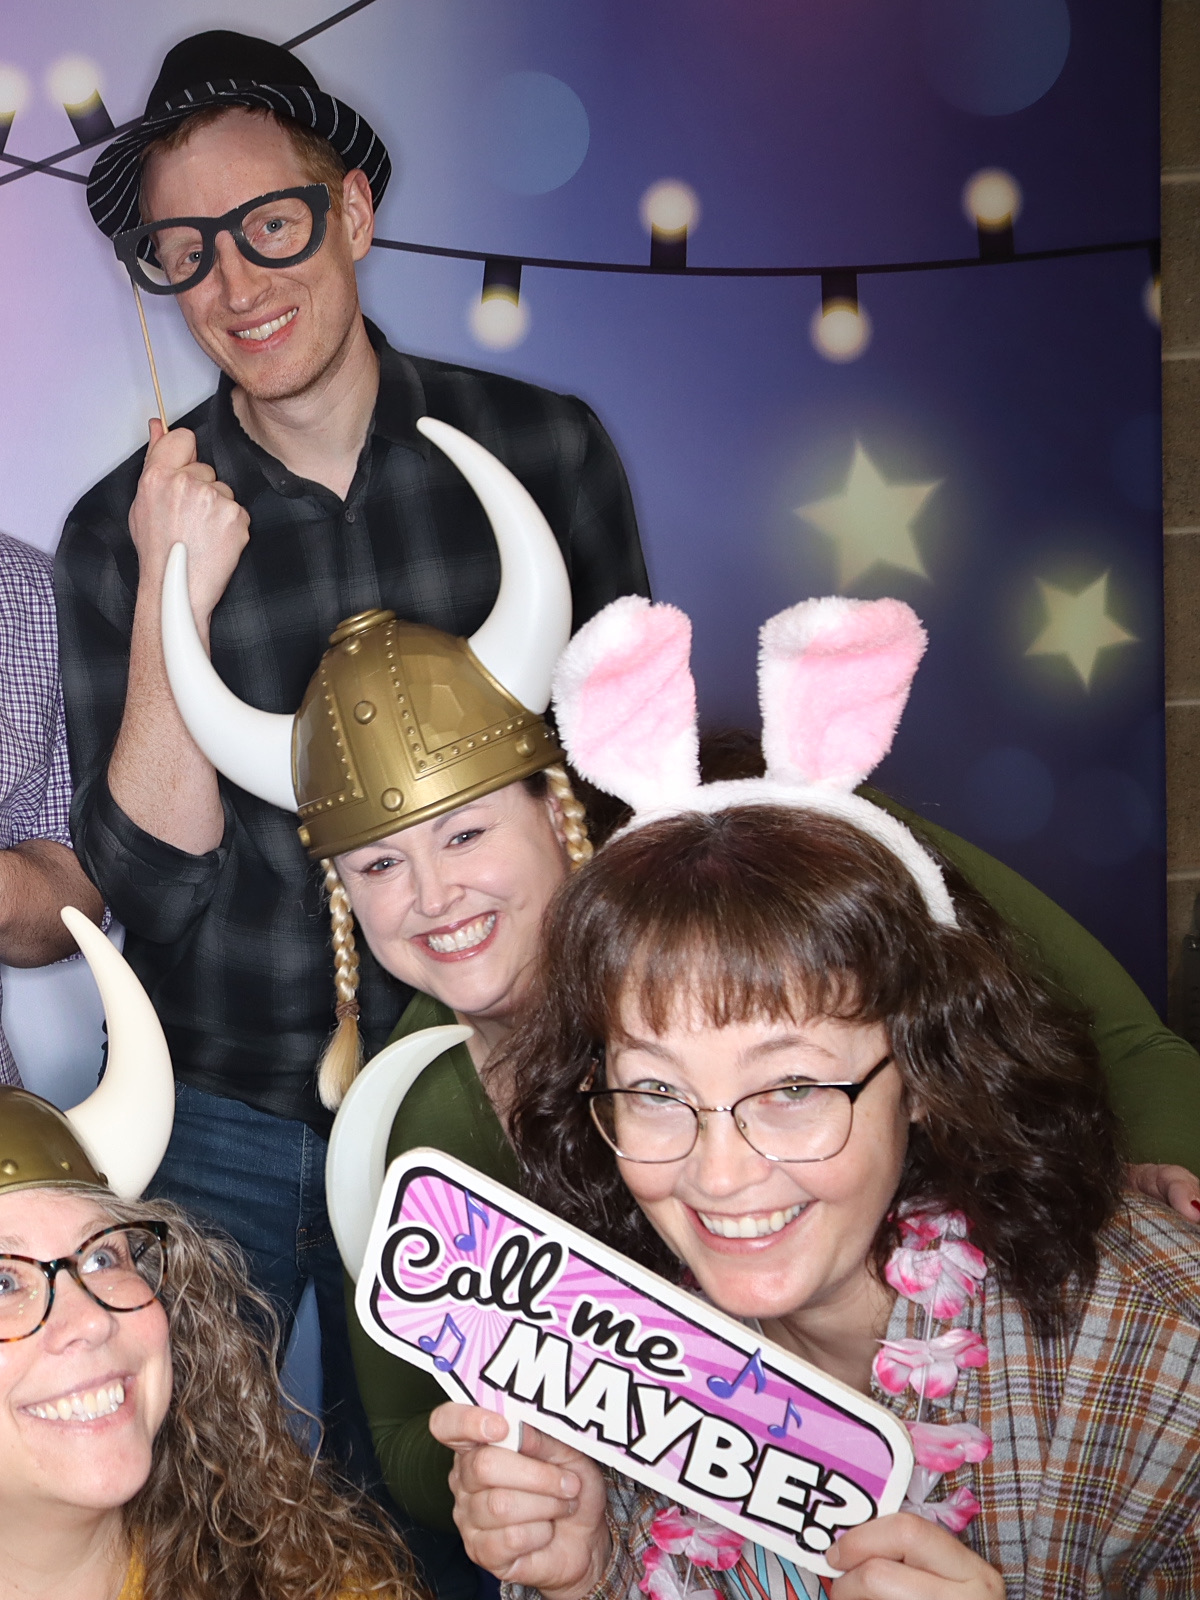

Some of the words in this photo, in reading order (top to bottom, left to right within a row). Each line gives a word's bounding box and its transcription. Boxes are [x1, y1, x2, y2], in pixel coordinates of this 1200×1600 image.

[381, 1226, 564, 1320] Call
[570, 1298, 685, 1377] me
[481, 1320, 878, 1554] MAYBE?
